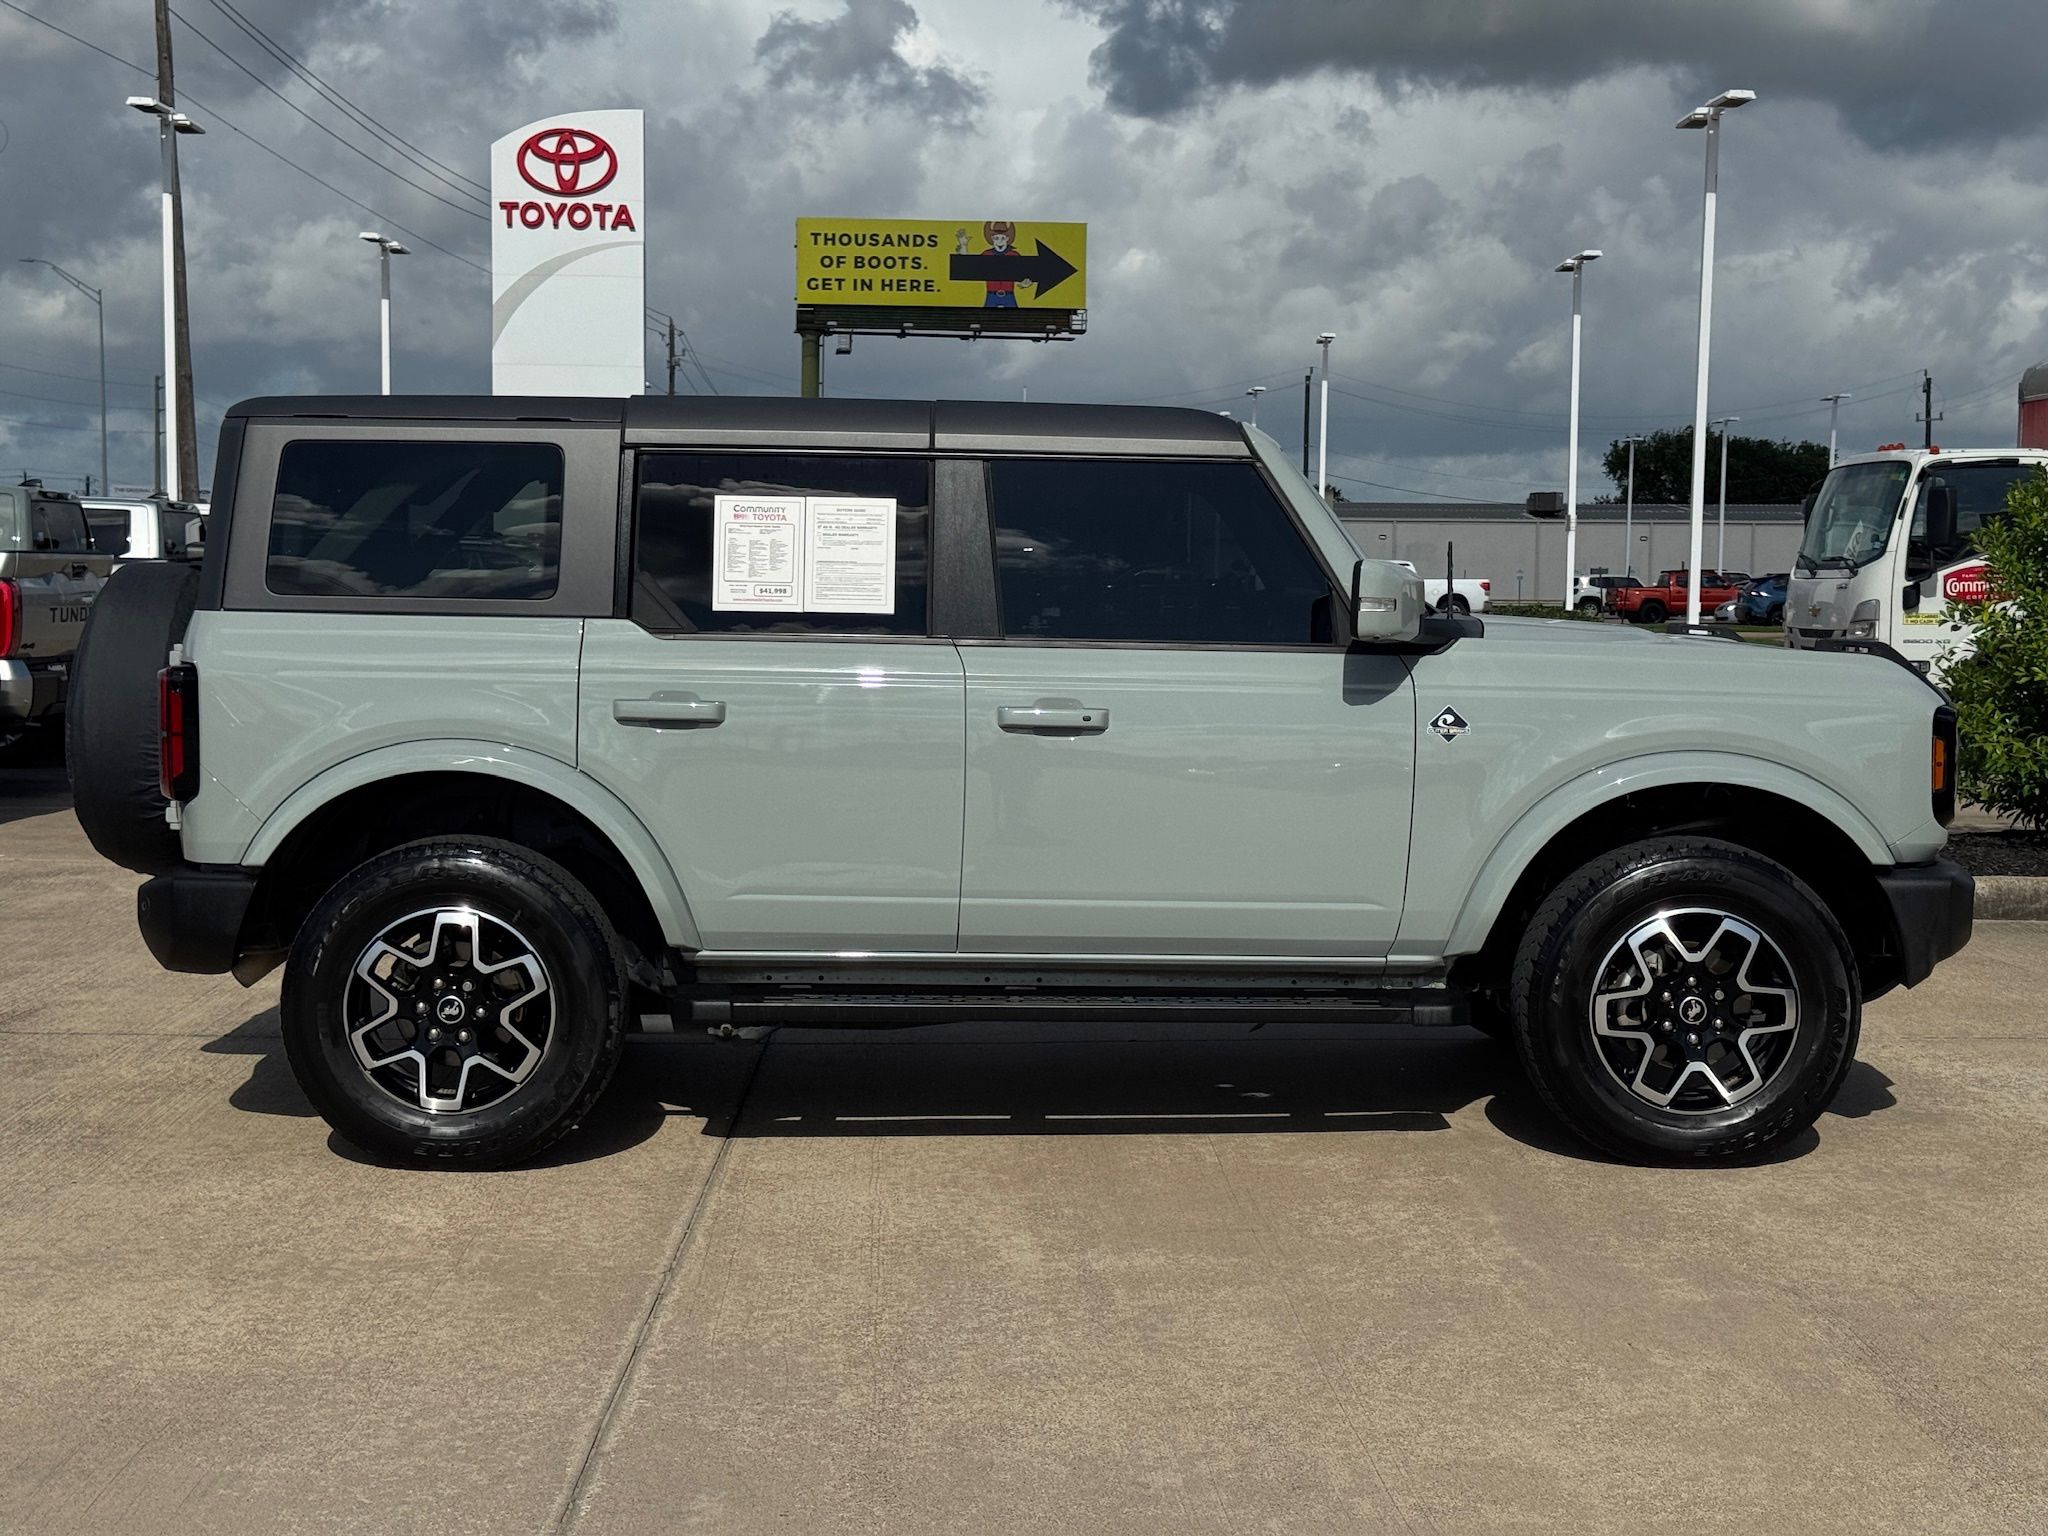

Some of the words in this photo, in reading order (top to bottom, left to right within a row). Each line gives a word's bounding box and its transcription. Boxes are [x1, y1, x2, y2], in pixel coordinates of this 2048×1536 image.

[499, 201, 636, 232] TOYOTA
[810, 232, 938, 248] THOUSANDS
[820, 255, 847, 268] OF
[853, 256, 928, 270] BOOTS.
[806, 277, 846, 291] GET
[853, 279, 873, 291] IN
[881, 279, 942, 293] HERE.
[752, 513, 787, 521] TOYOTA
[49, 606, 92, 623] TUND
